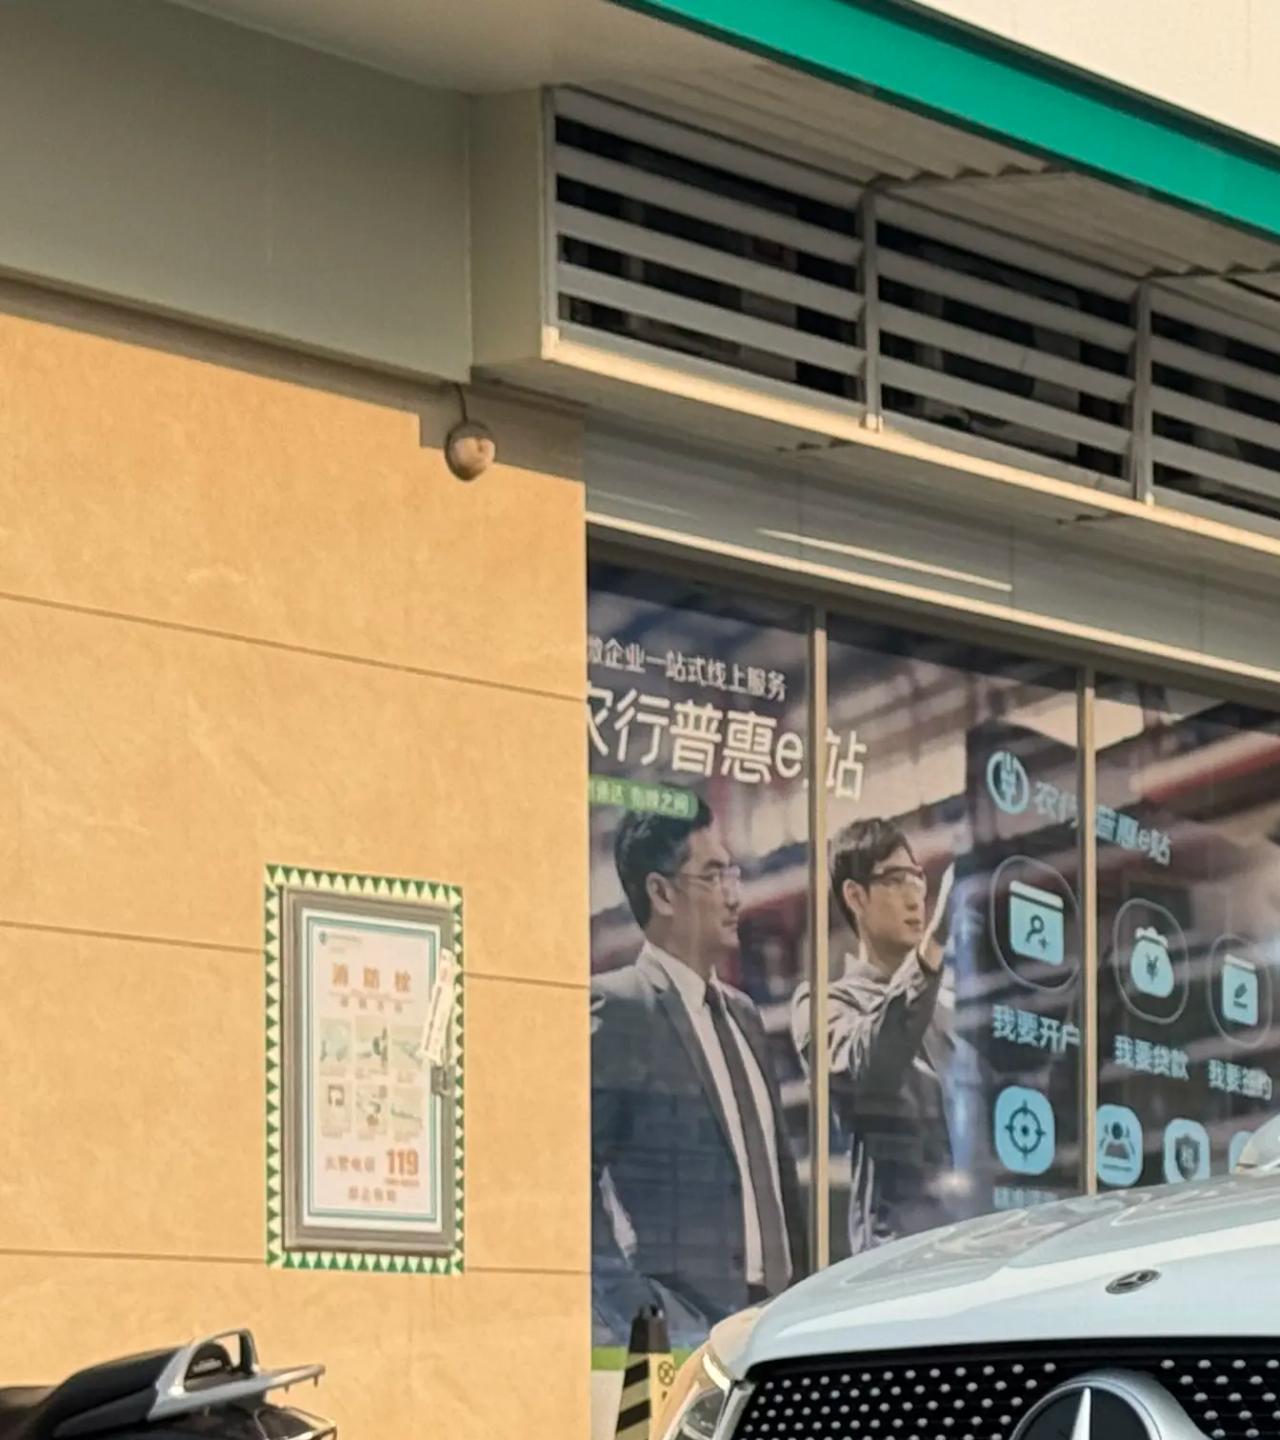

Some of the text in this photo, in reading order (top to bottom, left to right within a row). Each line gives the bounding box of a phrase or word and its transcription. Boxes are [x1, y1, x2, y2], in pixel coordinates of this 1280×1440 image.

[992, 1004, 1081, 1054] 我要开户
[387, 1148, 418, 1176] 119
